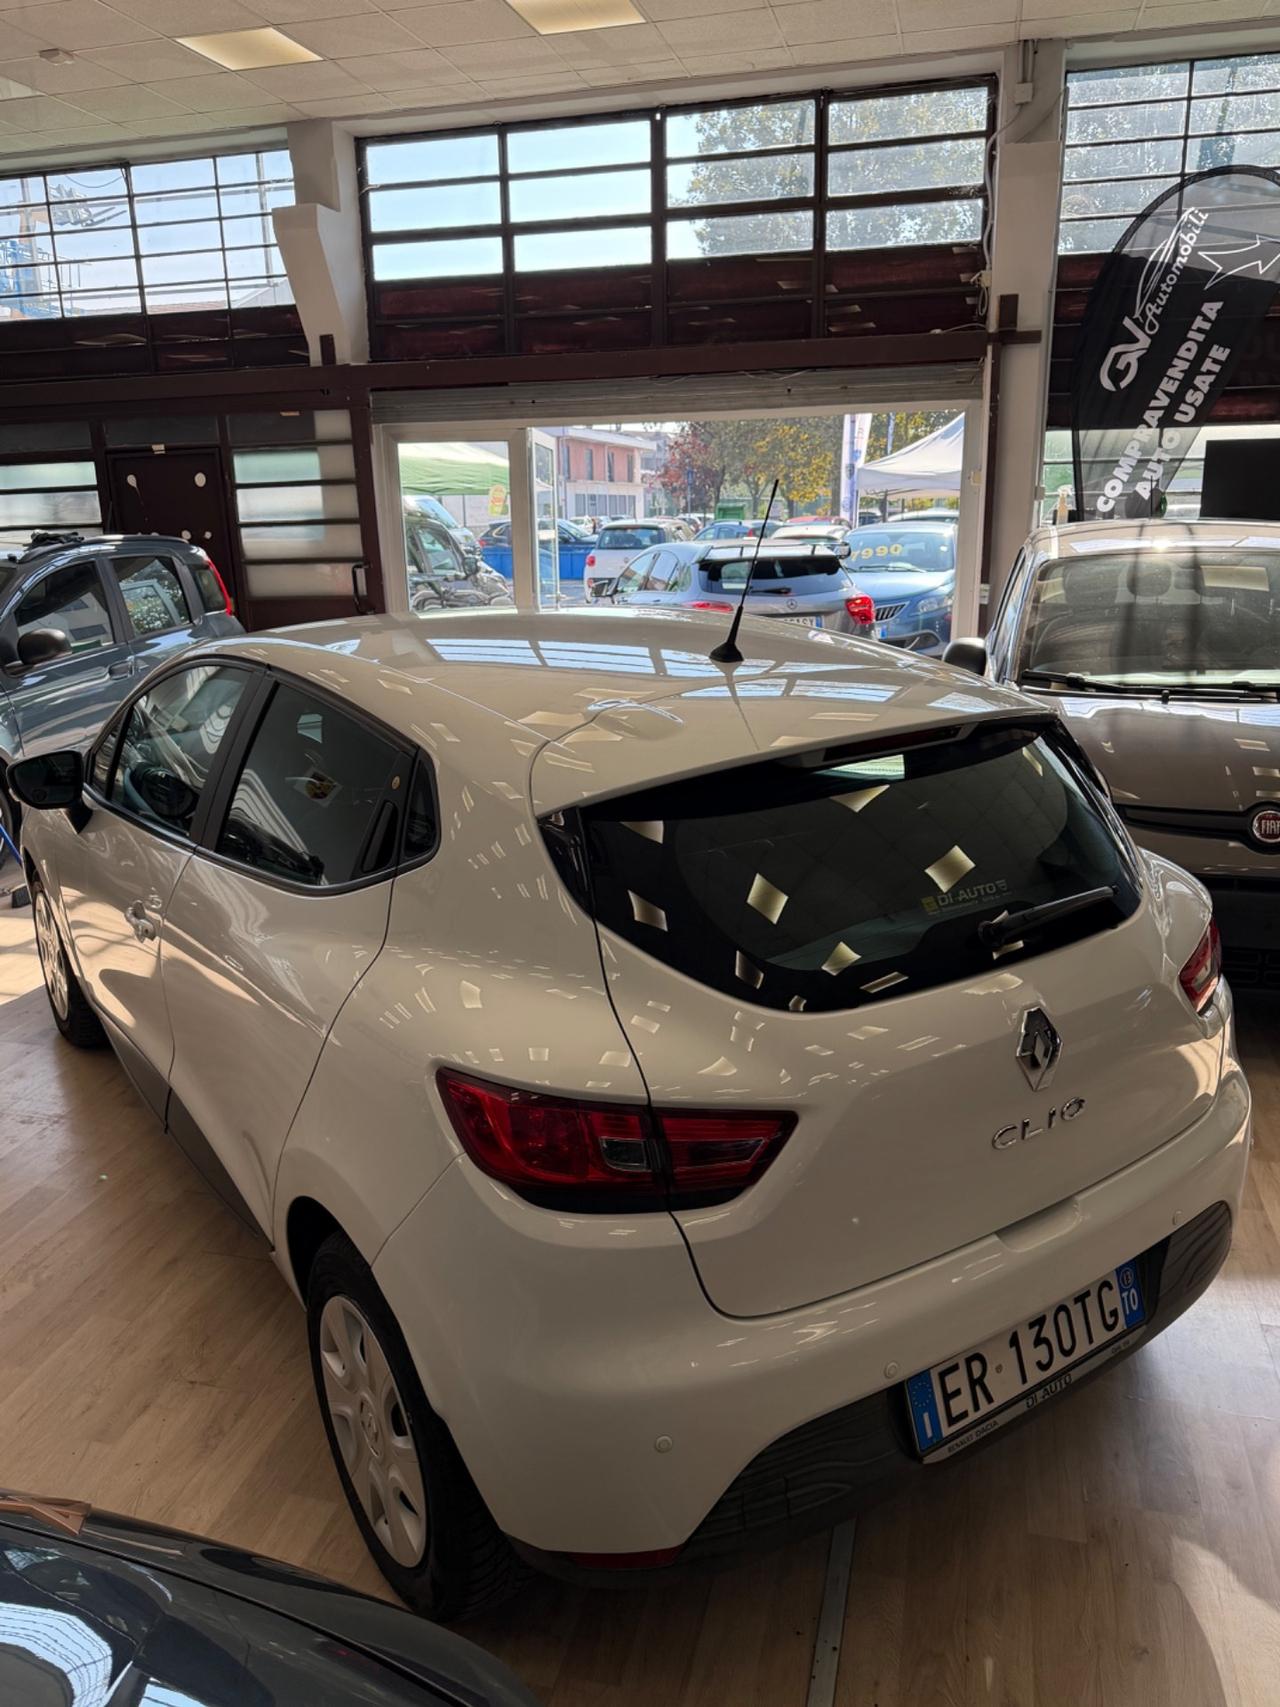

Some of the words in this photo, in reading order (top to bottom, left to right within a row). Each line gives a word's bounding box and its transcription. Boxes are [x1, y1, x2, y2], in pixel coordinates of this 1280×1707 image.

[1143, 208, 1209, 335] Automobili
[1096, 300, 1224, 513] COMPRAVENDITA
[1135, 430, 1181, 501] AUTO
[1173, 343, 1231, 424] USATE
[992, 1096, 1086, 1150] CLIO
[937, 1352, 994, 1428] ER
[1009, 1279, 1120, 1386] 130TG
[1121, 1287, 1139, 1315] TO
[1042, 1373, 1073, 1399] AUTO
